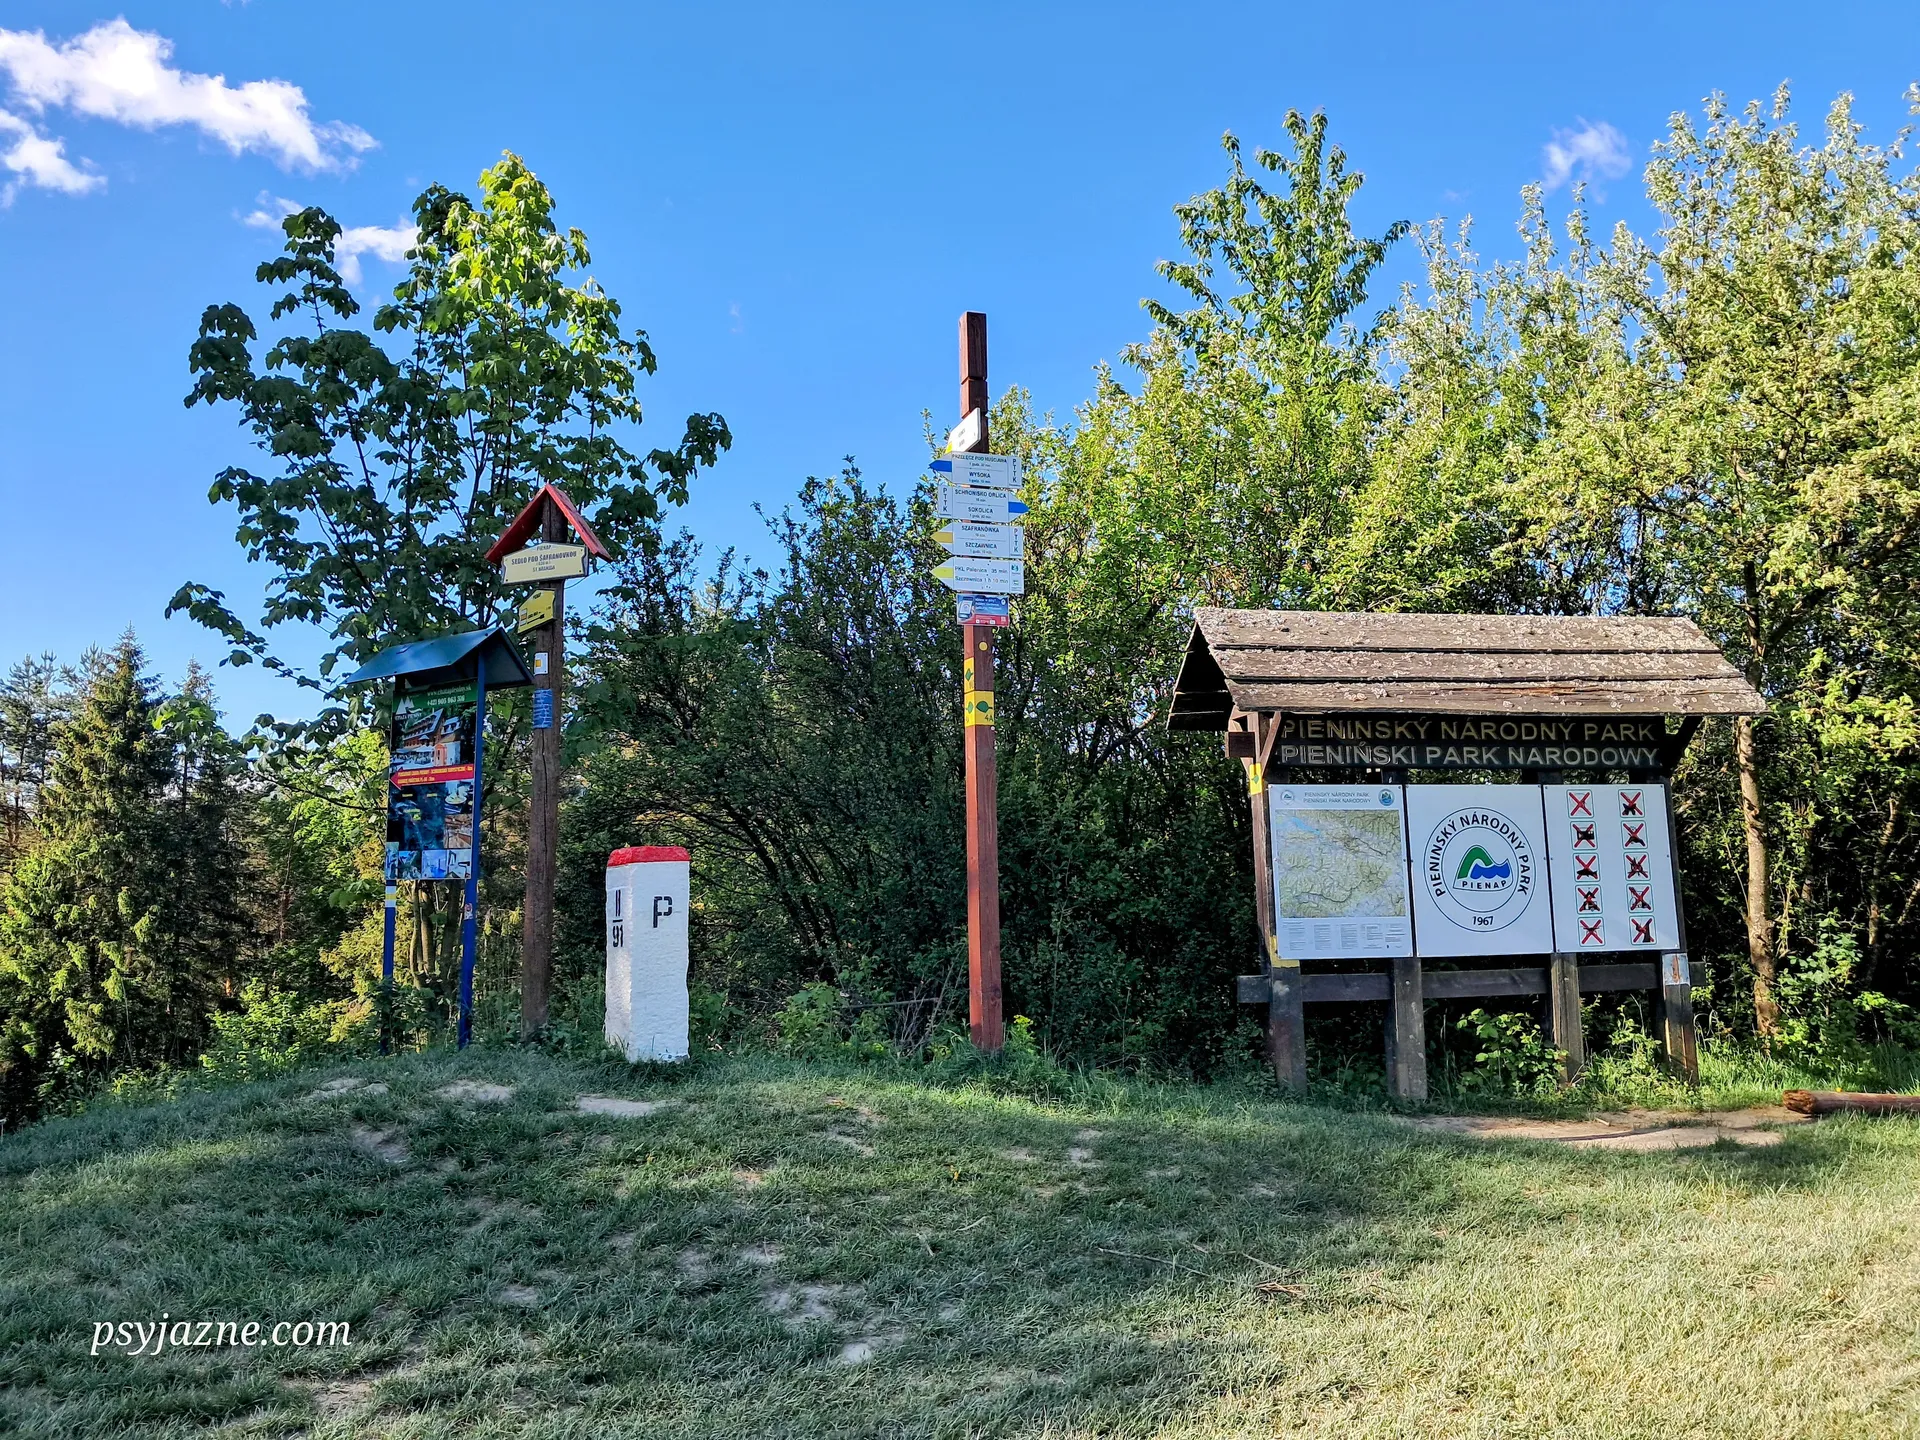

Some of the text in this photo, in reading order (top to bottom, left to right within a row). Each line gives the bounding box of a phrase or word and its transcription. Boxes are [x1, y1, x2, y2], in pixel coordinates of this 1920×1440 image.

[1281, 716, 1656, 741] PIENINSKÝ NÁRODNÝ PARK
[1281, 741, 1660, 766] PIENIŃSKI PARK NARODOWY
[1429, 811, 1530, 897] PIENINSKÝ NÁRODNÝ PARK
[1462, 880, 1507, 889] PIENAP
[652, 895, 673, 929] P
[1472, 916, 1494, 925] 1967
[612, 924, 624, 947] 91
